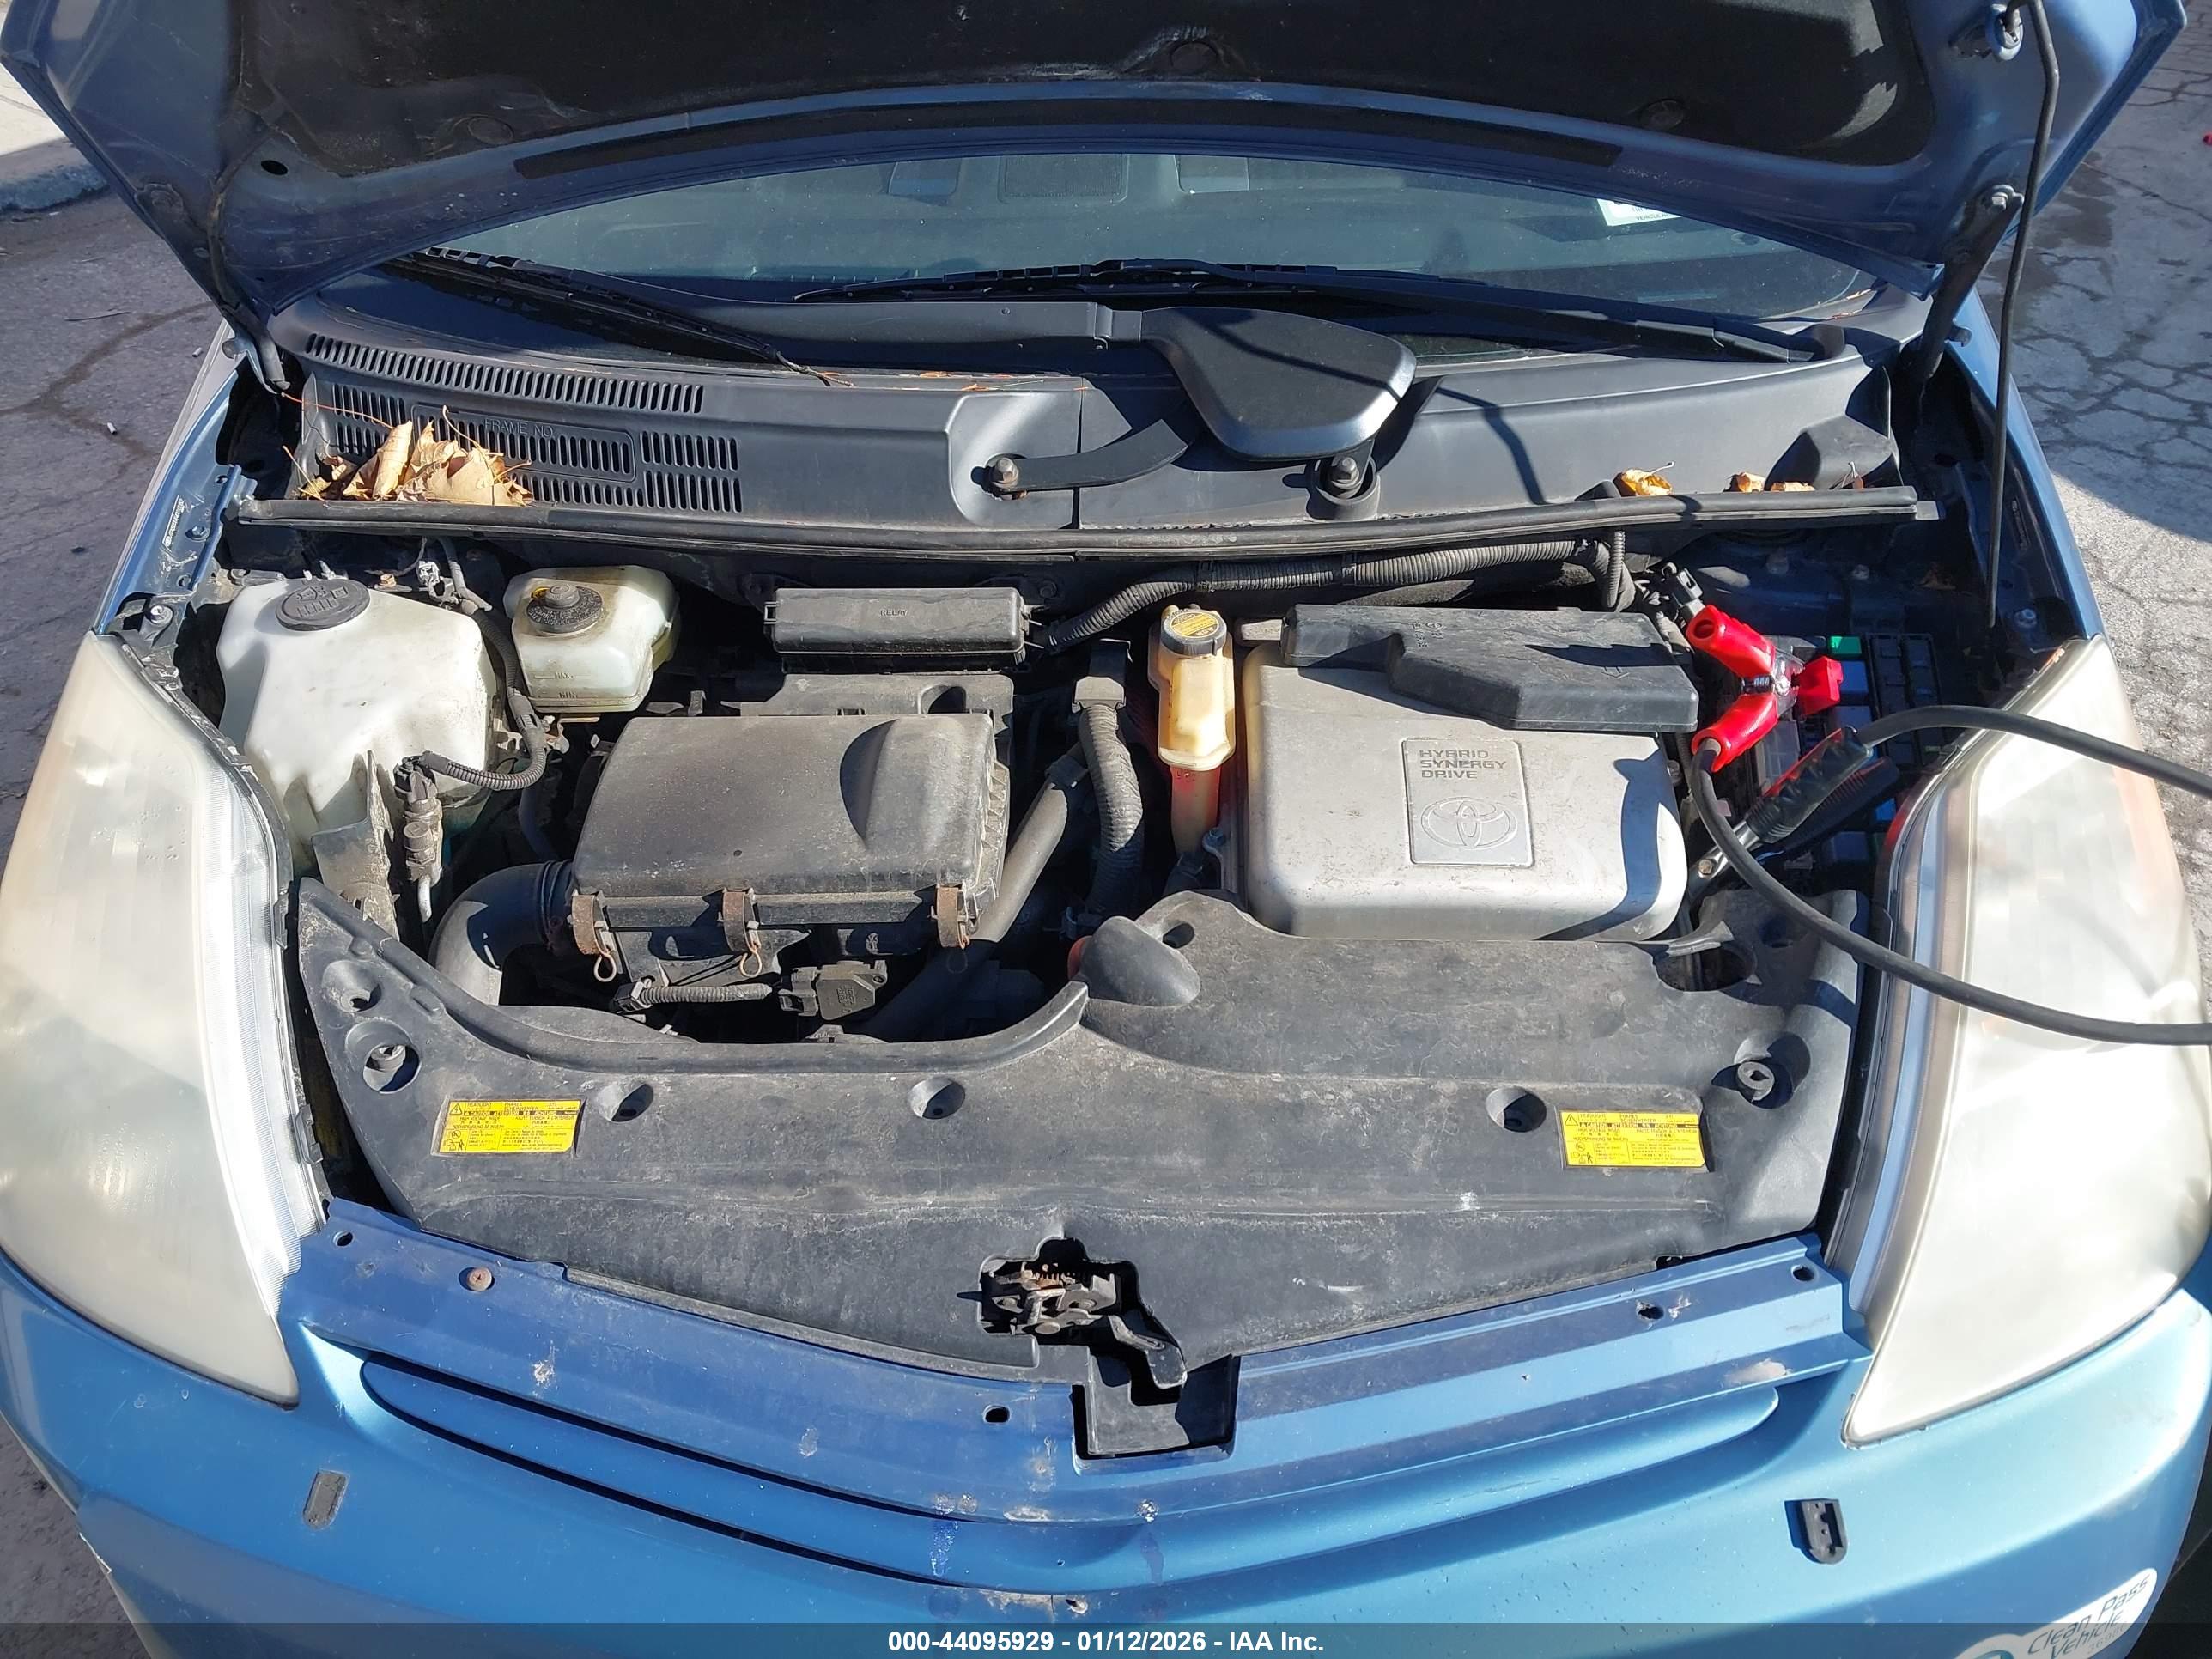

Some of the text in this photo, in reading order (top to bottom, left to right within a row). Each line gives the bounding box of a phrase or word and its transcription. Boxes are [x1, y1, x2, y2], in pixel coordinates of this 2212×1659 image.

[484, 417, 527, 434] FRAME
[1419, 750, 1489, 758] HYBRID
[1420, 759, 1506, 769] SYNERGY
[1421, 769, 1478, 779] DRIVE
[2027, 1614, 2092, 1655] Clean
[2098, 1574, 2150, 1621] Pass
[2051, 1610, 2124, 1659] Vehicle
